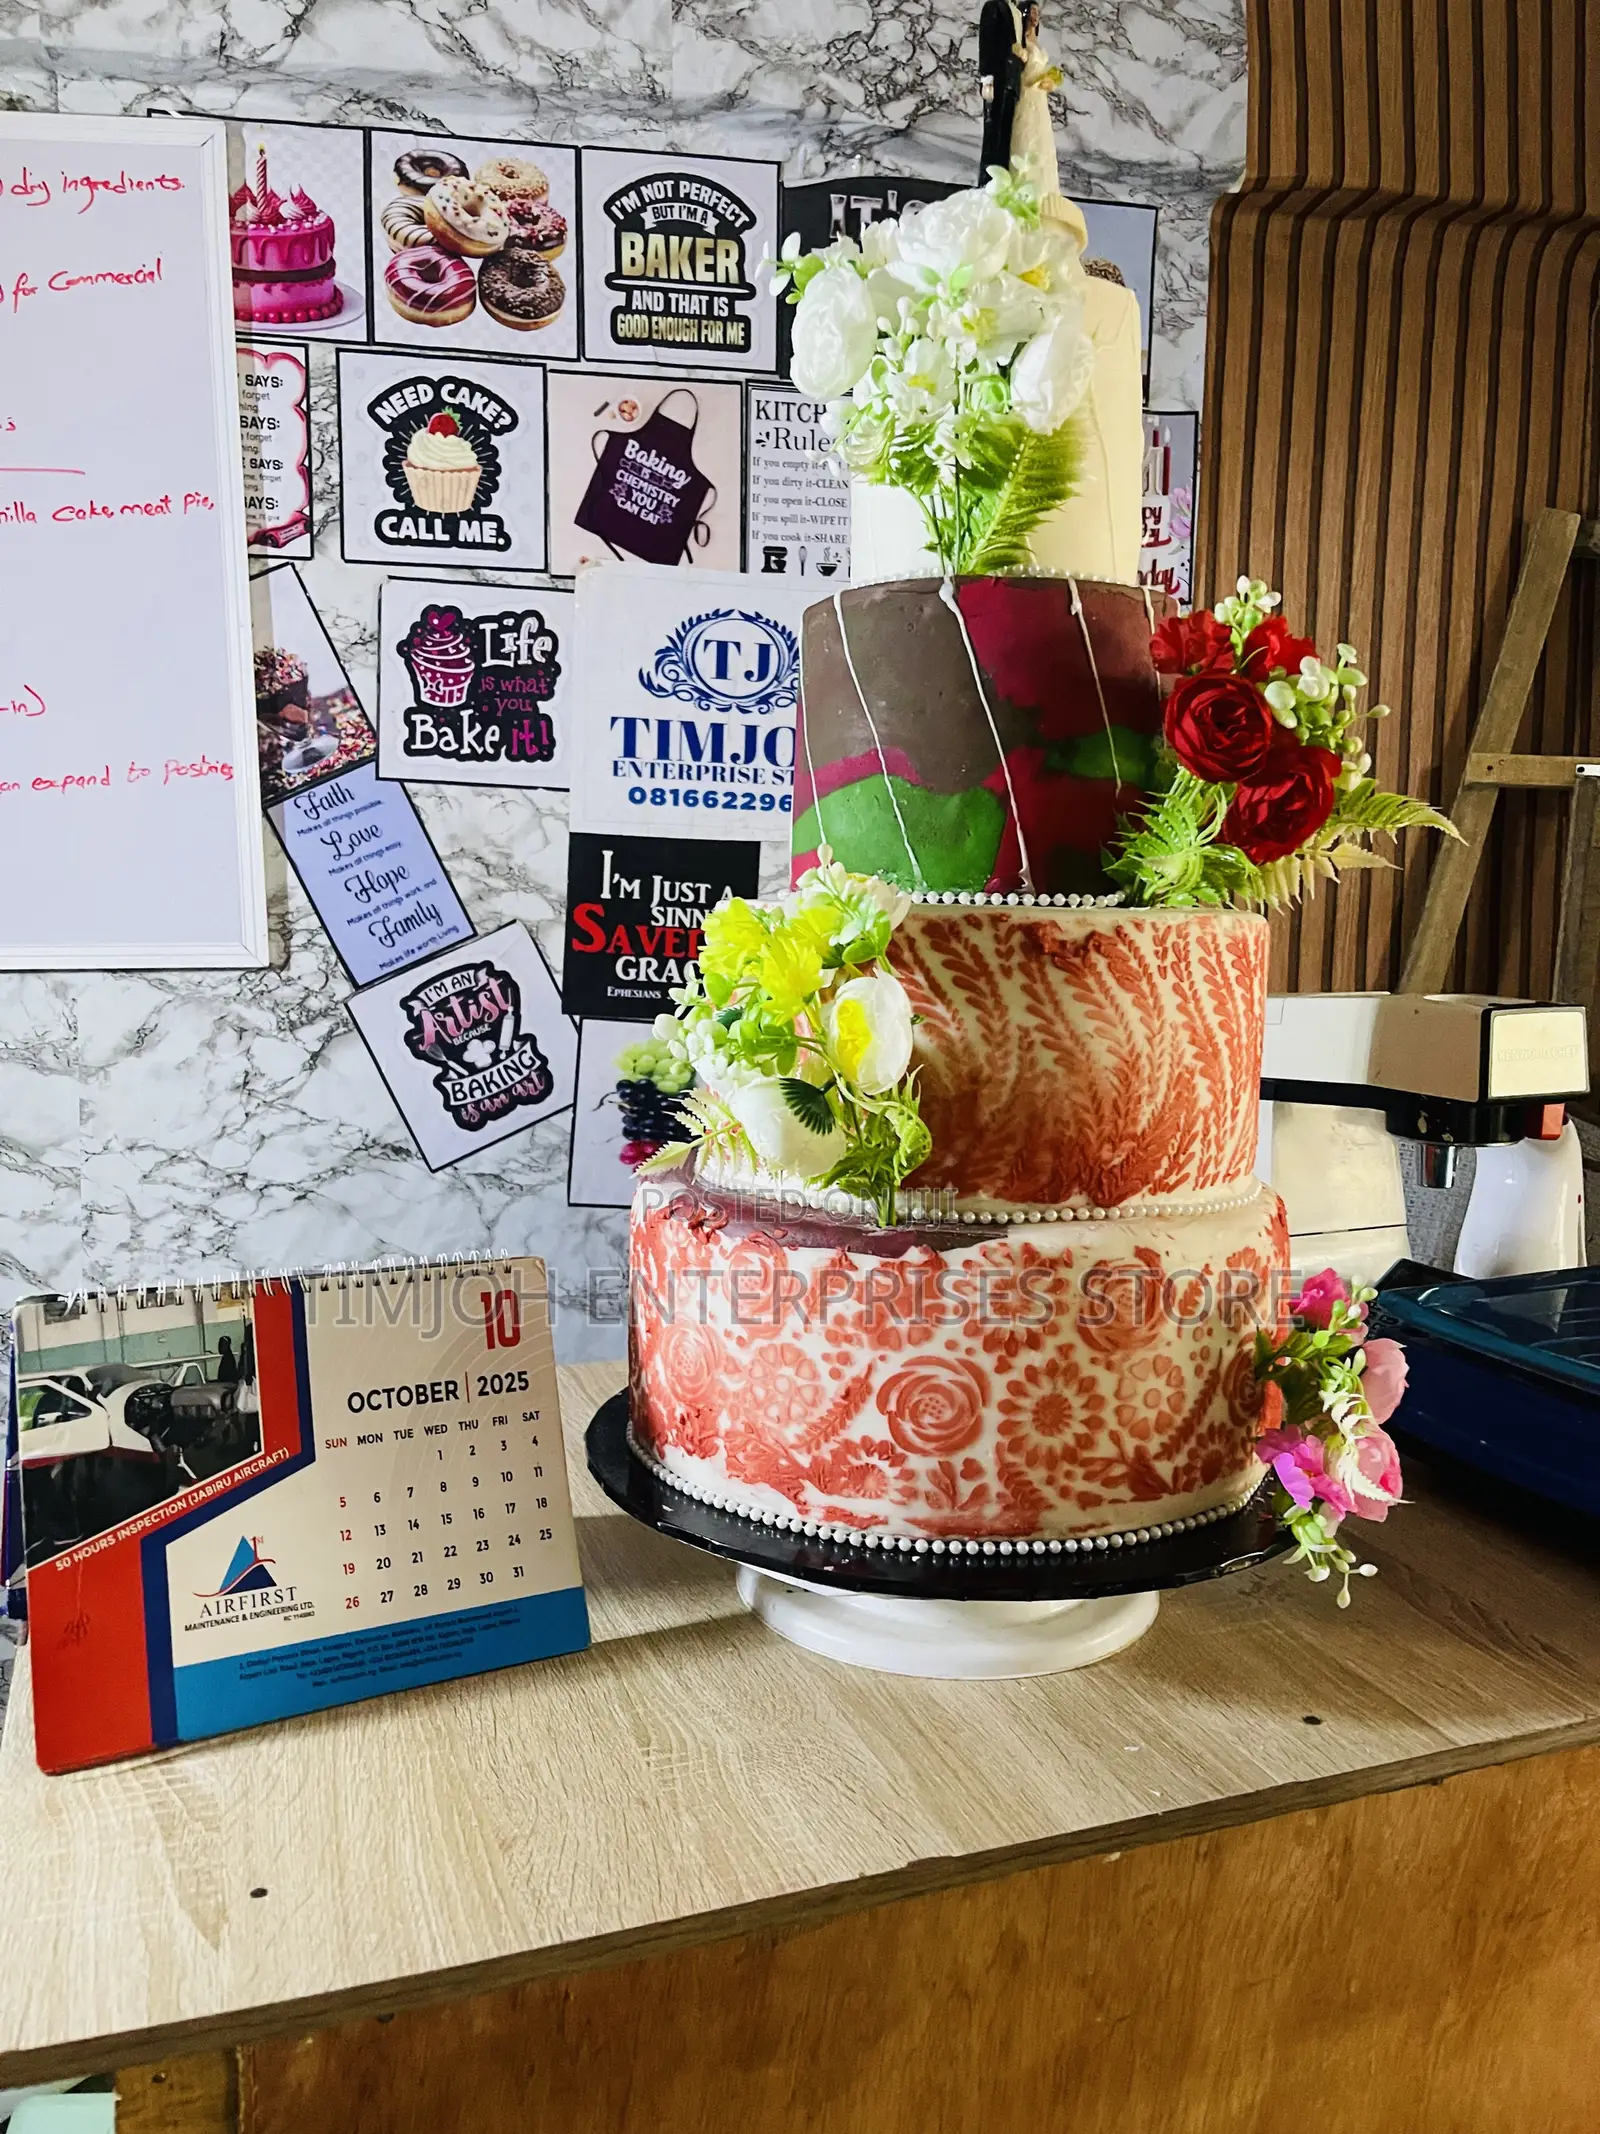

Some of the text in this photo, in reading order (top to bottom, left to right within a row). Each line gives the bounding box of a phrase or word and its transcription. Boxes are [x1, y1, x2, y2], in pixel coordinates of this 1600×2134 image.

[611, 180, 750, 228] I'M NOT PERFECT
[652, 205, 708, 225] BUT I'M A
[620, 231, 740, 284] BAKER
[12, 272, 38, 313] for
[631, 289, 729, 317] AND THAT IS
[616, 313, 745, 346] GOOD ENOUGH FOR ME
[242, 390, 271, 402] forget
[245, 374, 283, 388] SAYS:
[374, 383, 512, 430] NEED CAKE?
[755, 400, 827, 424] KITCH
[249, 458, 283, 470] SAYS:
[624, 439, 691, 490] Baking
[764, 460, 780, 470] you
[615, 469, 680, 508] CHEMISTRY
[764, 478, 779, 488] you
[120, 495, 172, 516] meat
[244, 496, 279, 510] AYS:
[616, 497, 661, 525] CAN EAT
[631, 489, 657, 511] YOU
[763, 497, 779, 506] you
[380, 515, 505, 545] CALL ME.
[479, 617, 553, 668] Life
[481, 676, 548, 695] is what
[495, 698, 533, 716] you
[410, 709, 550, 756] Bake it!
[610, 716, 797, 767] TIMJO
[127, 761, 151, 782] to
[612, 761, 766, 785] ENTERPRISE
[294, 782, 355, 820] Faith
[628, 786, 792, 812] 081662296
[297, 824, 323, 837] Makes
[320, 825, 383, 861] Love
[328, 863, 354, 876] Makes
[344, 866, 410, 904] Hope
[650, 875, 712, 908] JUST
[347, 911, 373, 926] Makes
[368, 900, 444, 948] Family
[650, 906, 711, 928] SINN
[379, 955, 404, 971] Makes
[424, 972, 473, 1005] I'M AN
[413, 978, 512, 1050] Artist
[452, 1023, 492, 1046] BECAUSE
[451, 1050, 537, 1102] BAKING
[461, 1071, 545, 1122] is an art
[480, 1289, 521, 1350] 10
[348, 1371, 529, 1413] OCTOBER 2025
[325, 1411, 540, 1449] SUN MON TUE WED THU FRI SAT
[437, 1436, 539, 1461] 1 2 3 4
[339, 1466, 543, 1508] 5 6 7 8 9 10 11
[56, 1447, 290, 1571] 50 HOURS INSPECTION (JABIRU AIRCRAFT)
[340, 1497, 548, 1541] 12 13 14 15 16 17 18
[343, 1528, 552, 1575] 19 20 21 22 23 24 25
[200, 1586, 297, 1618] AIRFIRST
[345, 1566, 525, 1609] 26 27 28 29 30 31
[184, 1615, 240, 1631] MAINTENANCE
[242, 1613, 248, 1621] &
[250, 1603, 299, 1620] ENGINEERING
[300, 1601, 315, 1610] LTD.
